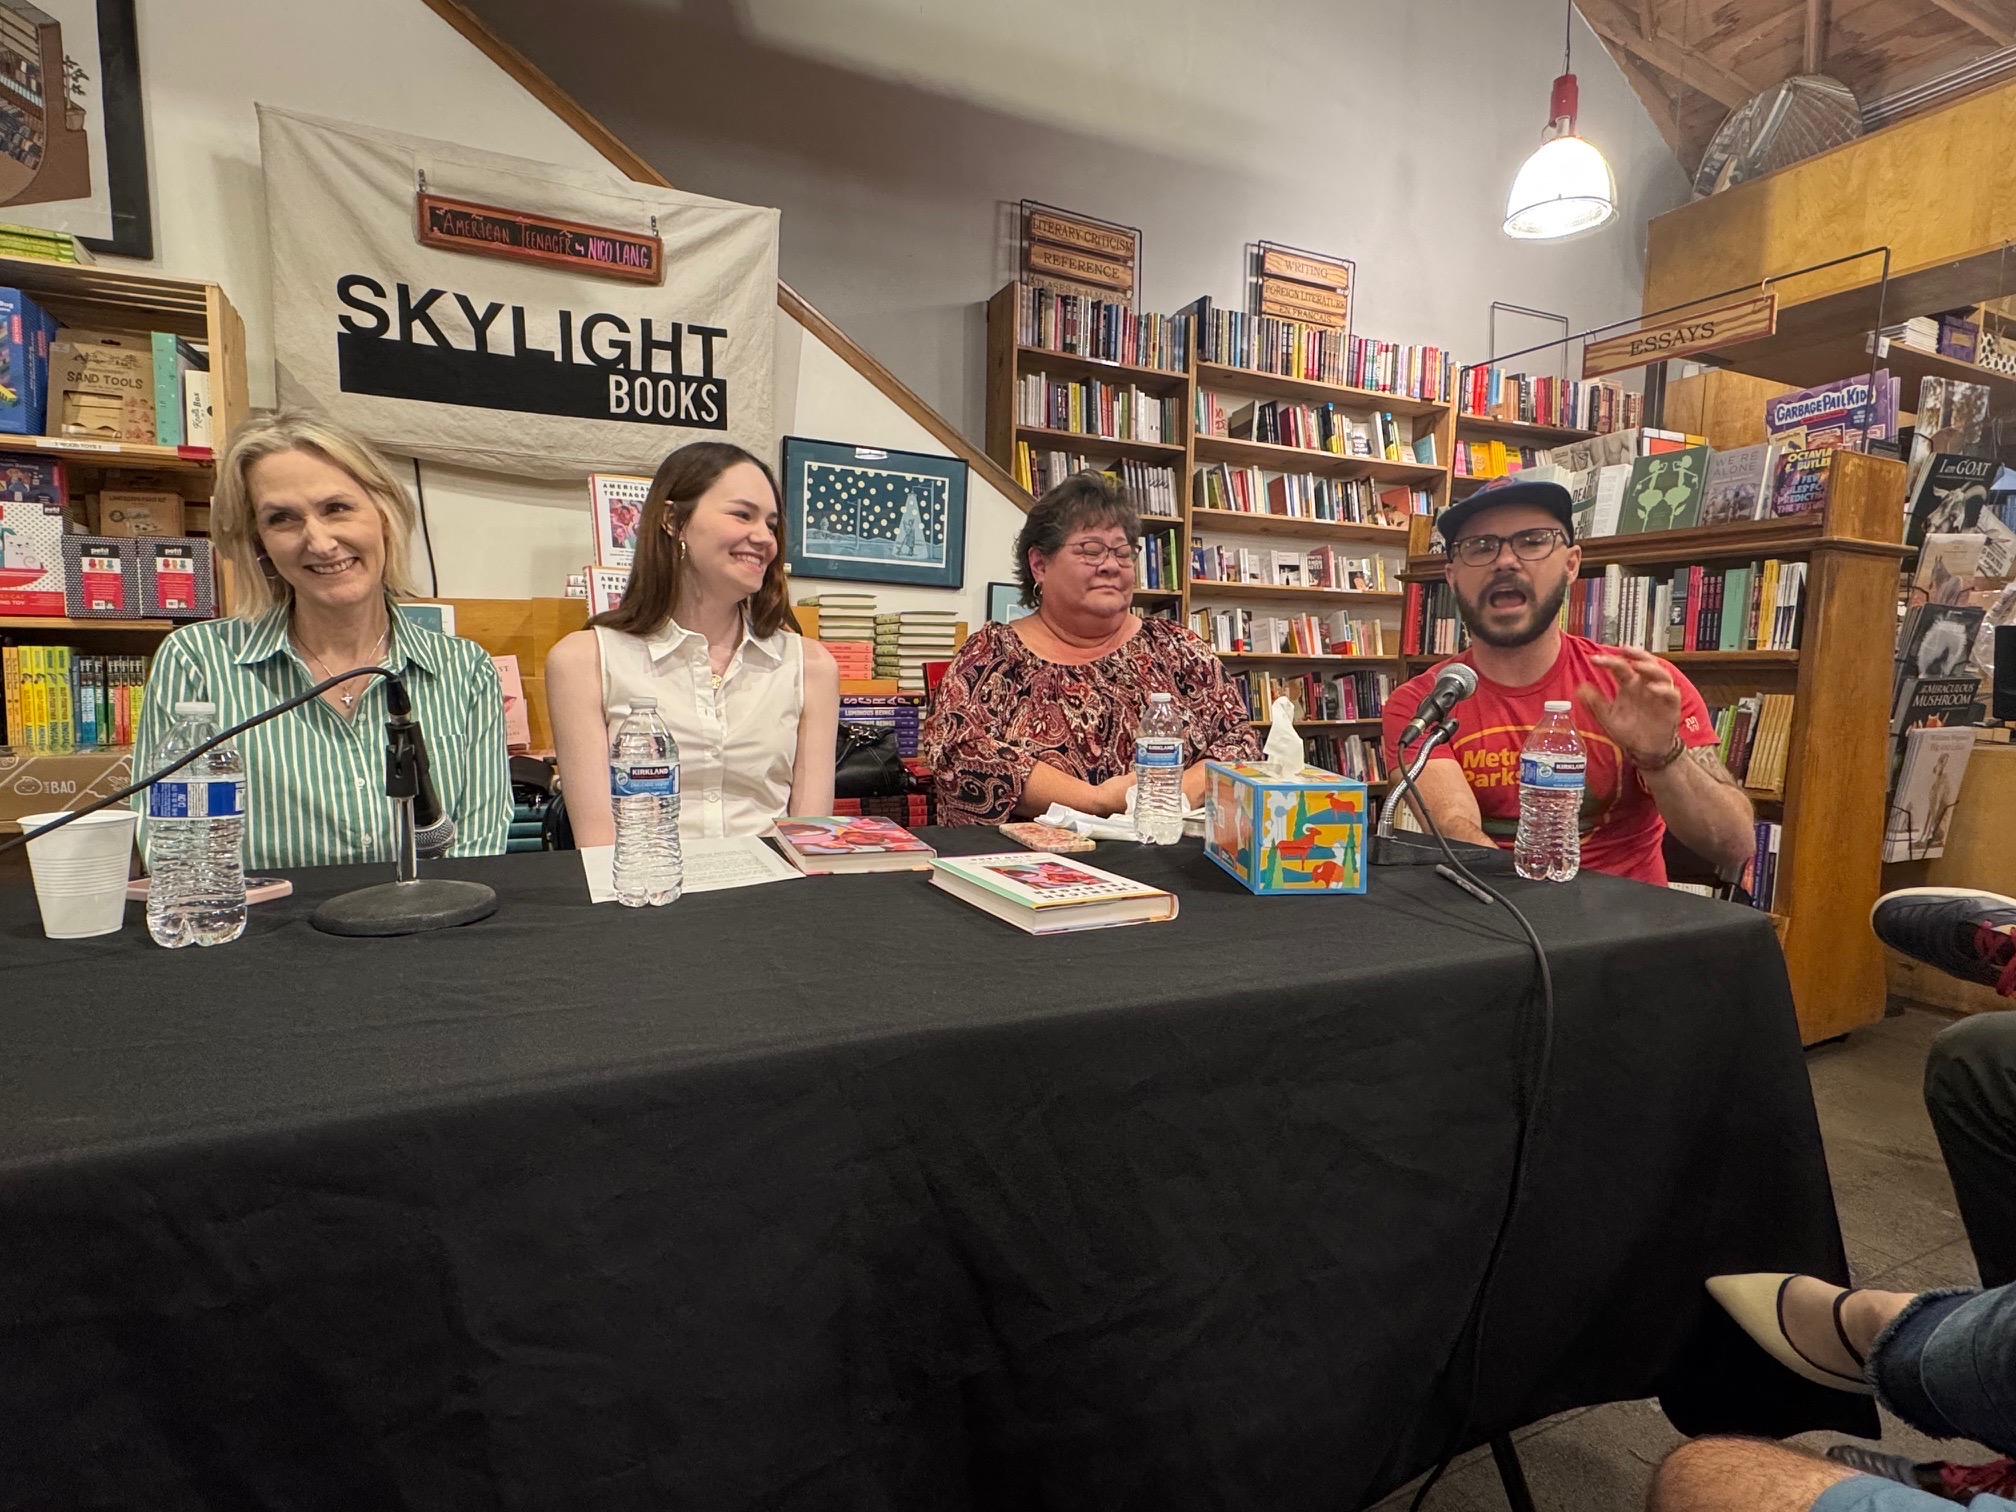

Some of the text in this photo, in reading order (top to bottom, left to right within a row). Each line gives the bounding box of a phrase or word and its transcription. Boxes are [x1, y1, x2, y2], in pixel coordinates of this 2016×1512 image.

[443, 214, 648, 268] AMERICAN TEENAGER NICO LANG
[1033, 218, 1134, 252] LITERARY CRITICISM
[1044, 252, 1120, 279] REFERENCE
[1285, 260, 1328, 278] WRITING
[1265, 284, 1346, 308] FOREIGN LITERATURE
[1280, 305, 1290, 314] EN
[337, 273, 728, 379] SKYLIGHT
[1628, 321, 1716, 357] ESSAYS
[66, 371, 144, 390] SAND TOOLS
[193, 392, 201, 408] Box
[609, 373, 719, 423] BOOKS
[1776, 400, 1822, 422] GARBAGE
[1822, 394, 1846, 413] PAIL
[1846, 386, 1873, 406] KID
[1788, 448, 1832, 462] OCTAVIA
[1714, 462, 1757, 476] ALONE
[1939, 458, 1948, 473] I
[1956, 459, 1992, 476] GOAT
[604, 490, 646, 499] TEENAGE
[1926, 684, 1974, 694] MIRACULOUS
[843, 696, 911, 706] SCRAP
[1912, 694, 1972, 706] MUSHROOM
[1463, 748, 1520, 768] Metr
[51, 780, 76, 794] BAO
[1034, 882, 1132, 895] TEENAGER
[1043, 886, 1139, 899] AMERICAN
